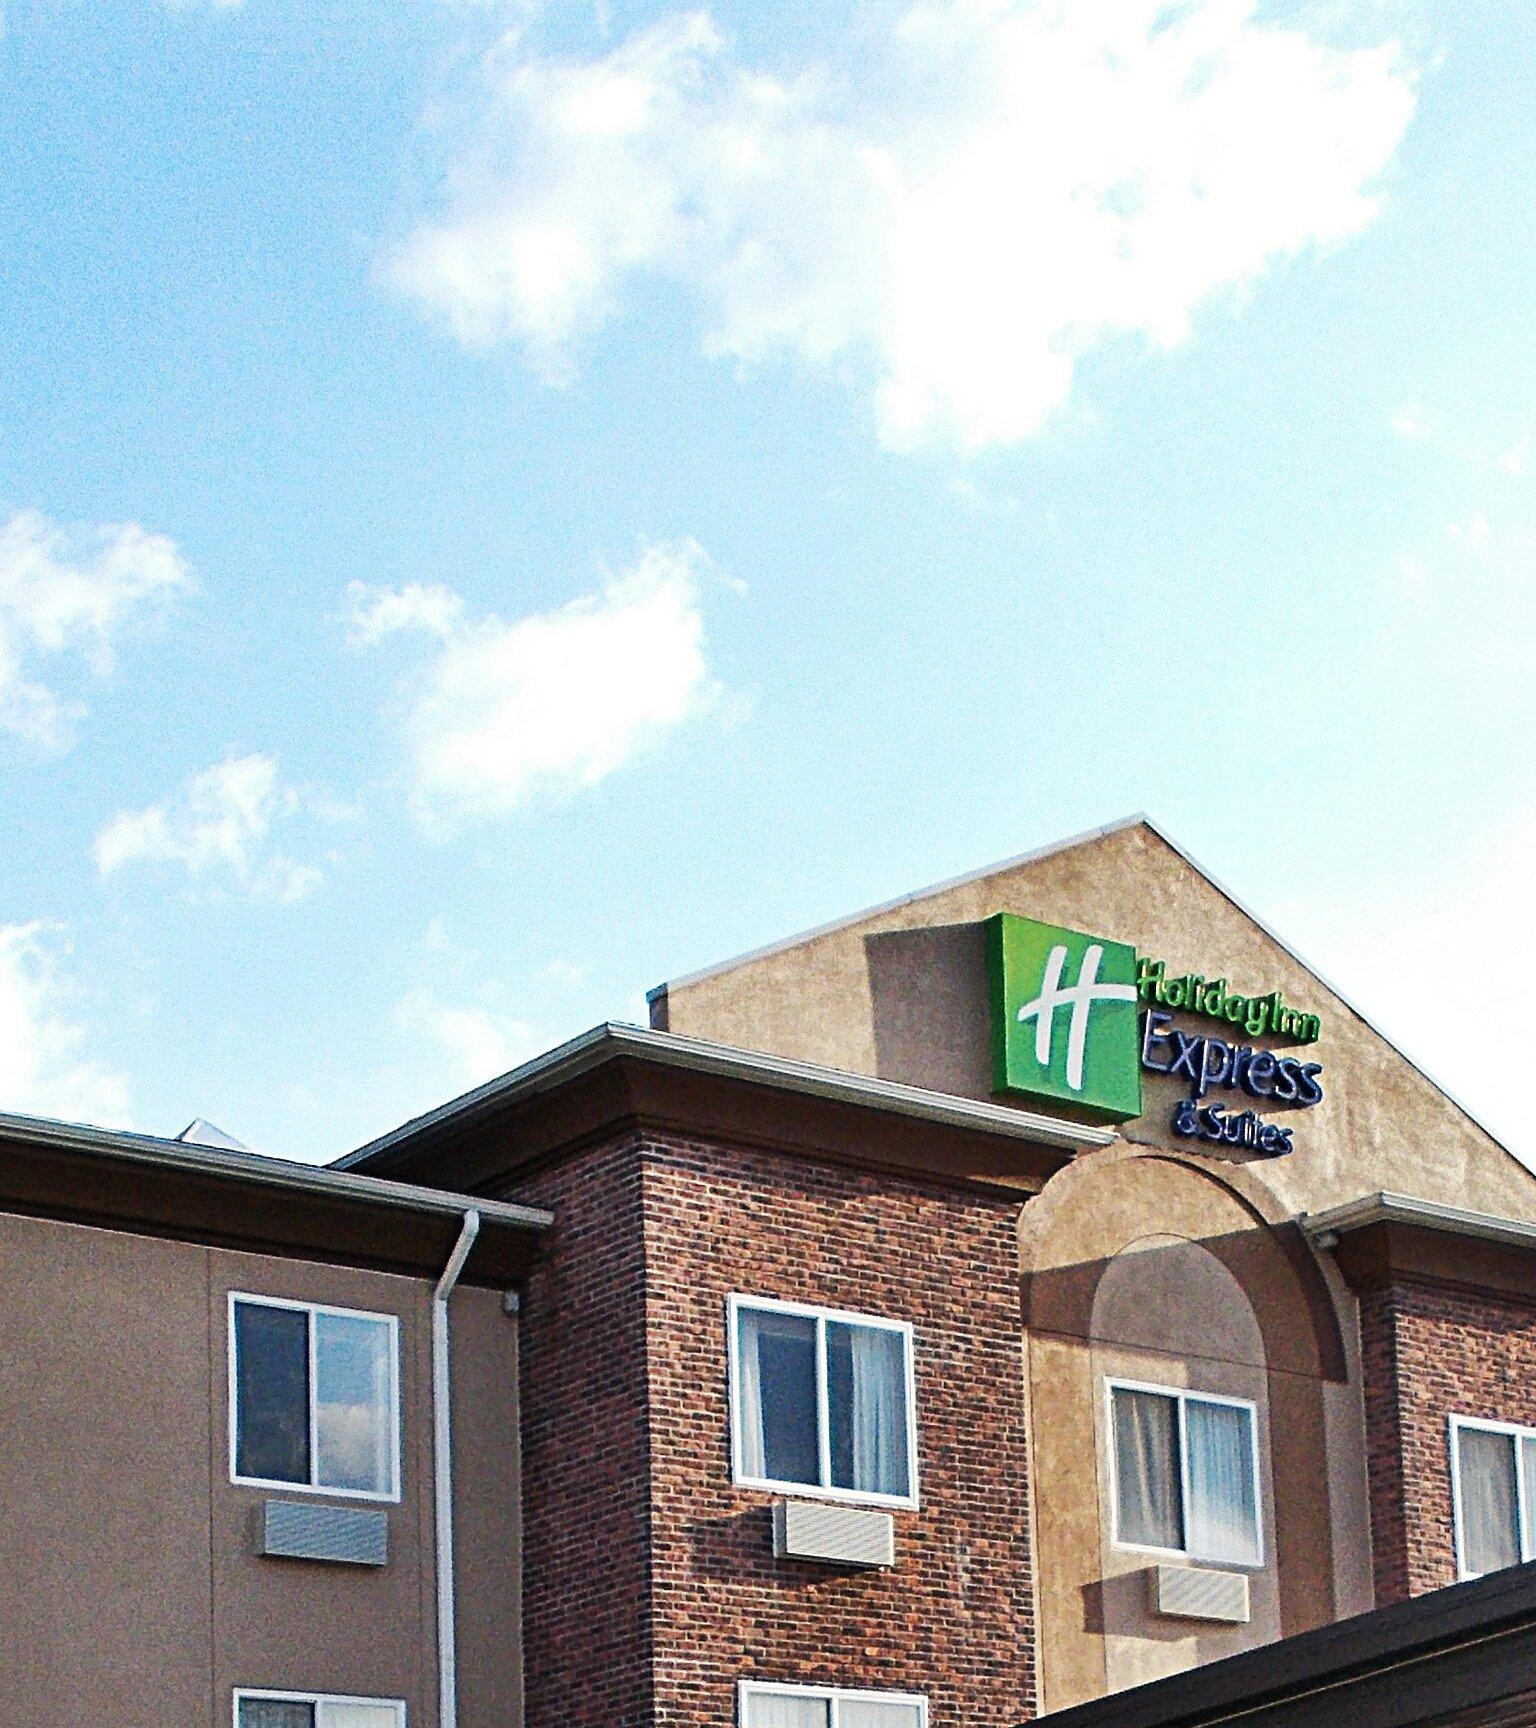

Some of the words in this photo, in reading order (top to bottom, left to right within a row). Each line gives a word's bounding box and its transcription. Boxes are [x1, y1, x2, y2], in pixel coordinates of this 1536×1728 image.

[1017, 945, 1138, 1091] H
[1138, 957, 1270, 1037] Holiday
[1270, 991, 1322, 1044] Inn
[1141, 1008, 1324, 1105] Express
[1173, 1100, 1199, 1138] &
[1203, 1103, 1294, 1157] Suites
